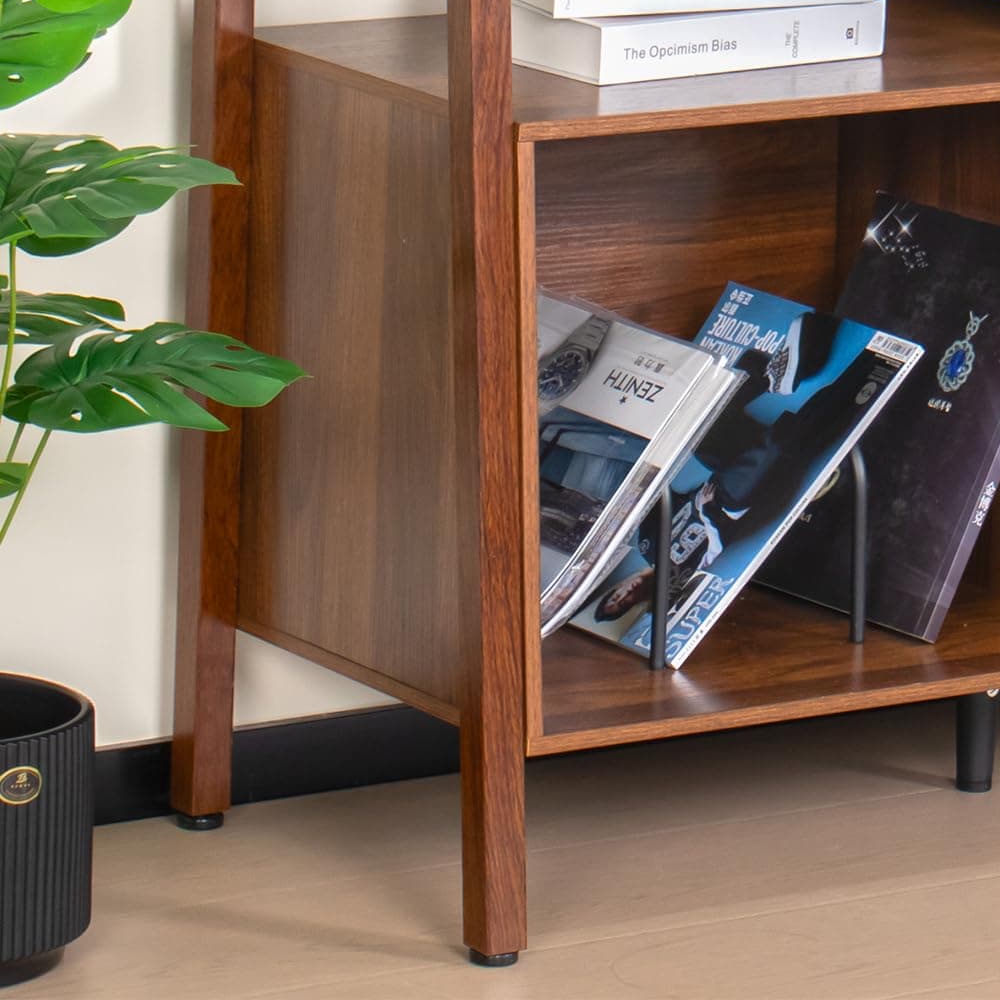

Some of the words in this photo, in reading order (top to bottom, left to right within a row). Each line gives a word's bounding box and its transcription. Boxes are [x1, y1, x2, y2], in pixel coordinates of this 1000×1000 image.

[624, 47, 646, 60] The
[712, 39, 737, 51] Bias
[707, 314, 786, 354] POP-CULTURE
[603, 368, 664, 403] ZENITH
